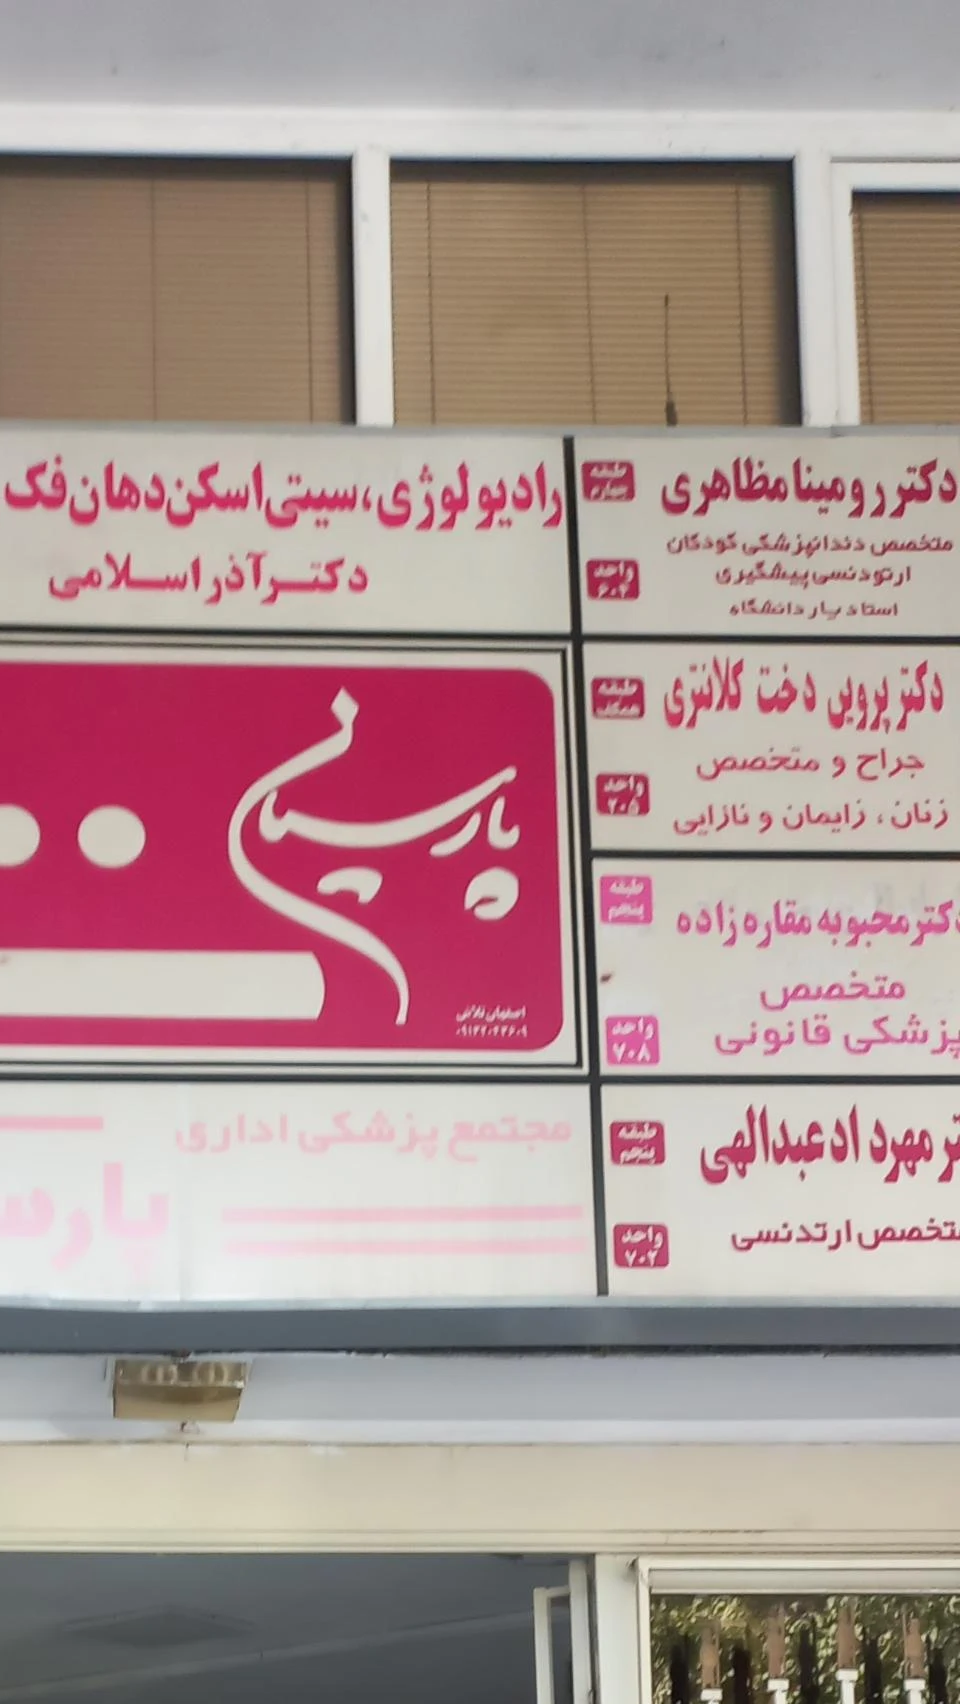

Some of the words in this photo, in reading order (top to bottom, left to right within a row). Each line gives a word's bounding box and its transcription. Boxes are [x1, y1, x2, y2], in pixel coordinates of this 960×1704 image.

[5, 455, 67, 510] فک
[69, 460, 165, 526] دهان
[167, 461, 262, 527] اسکن
[266, 473, 356, 528] سیتی
[661, 456, 789, 517] مظاهری
[793, 457, 887, 519] رومینا
[890, 459, 960, 519] دکتر
[666, 533, 737, 554] کودکان
[742, 533, 865, 558] دندانپزشکی
[870, 536, 953, 556] متخصص
[48, 552, 202, 602] اسلامی
[204, 551, 267, 607] آذر
[262, 558, 369, 606] دکتر
[715, 561, 811, 590] پیشگیری
[812, 566, 911, 587] ارتودنسی
[730, 600, 803, 617] دانشگاه
[663, 655, 745, 730] کلانتری
[756, 664, 817, 716] دخت
[896, 659, 944, 733] دکتر
[696, 748, 820, 782] متخصص
[832, 755, 847, 779] و
[856, 748, 925, 782] جراح
[673, 803, 750, 836] نازایی
[759, 811, 774, 833] و
[782, 799, 867, 833] زایمان
[816, 905, 911, 948] محبوبه
[759, 971, 906, 1012] متخصص
[612, 1042, 651, 1063] ۷۰۸
[715, 1014, 832, 1056] قانونی
[175, 1114, 288, 1155] اداری
[298, 1112, 438, 1158] پزشکی
[447, 1115, 572, 1164] مجتمع
[700, 1104, 826, 1185] عبدالهی
[830, 1103, 934, 1184] مهرداد
[732, 1220, 852, 1252] ارتدنسی
[857, 1217, 960, 1252] تخصص
